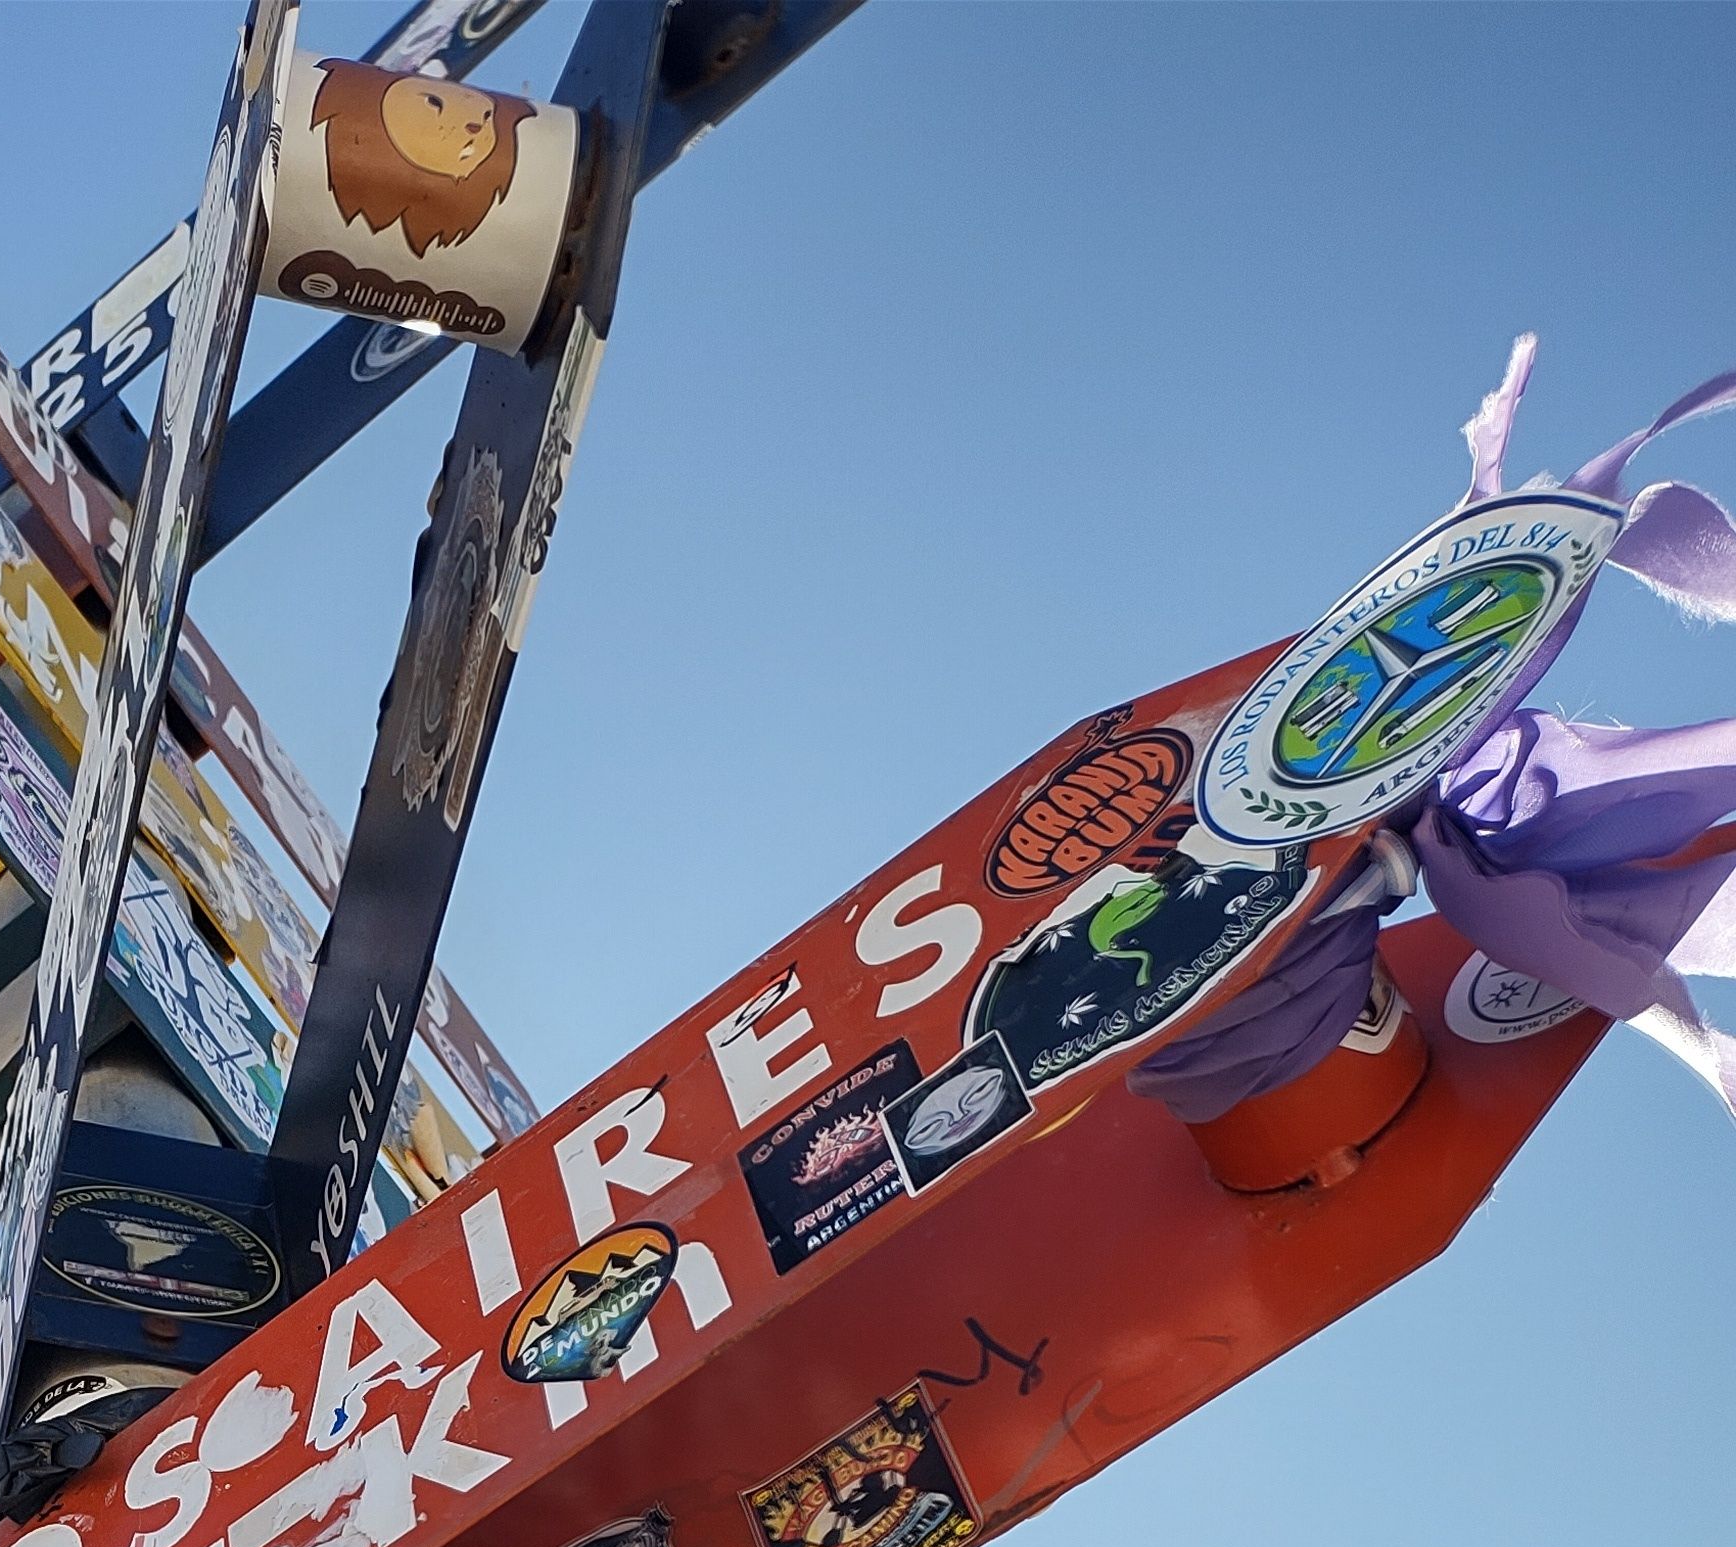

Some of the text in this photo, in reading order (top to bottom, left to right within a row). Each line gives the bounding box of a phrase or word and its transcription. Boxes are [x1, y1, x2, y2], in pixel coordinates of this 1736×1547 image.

[1220, 520, 1572, 791] LOS RODANTEROS DEL 814
[994, 740, 1179, 890] NARANJA
[1061, 785, 1168, 874] BUM
[304, 862, 983, 1452] AIRES
[803, 1176, 908, 1254] ARGENTIN
[518, 1334, 558, 1366] DE
[555, 1274, 663, 1358] MUNDO
